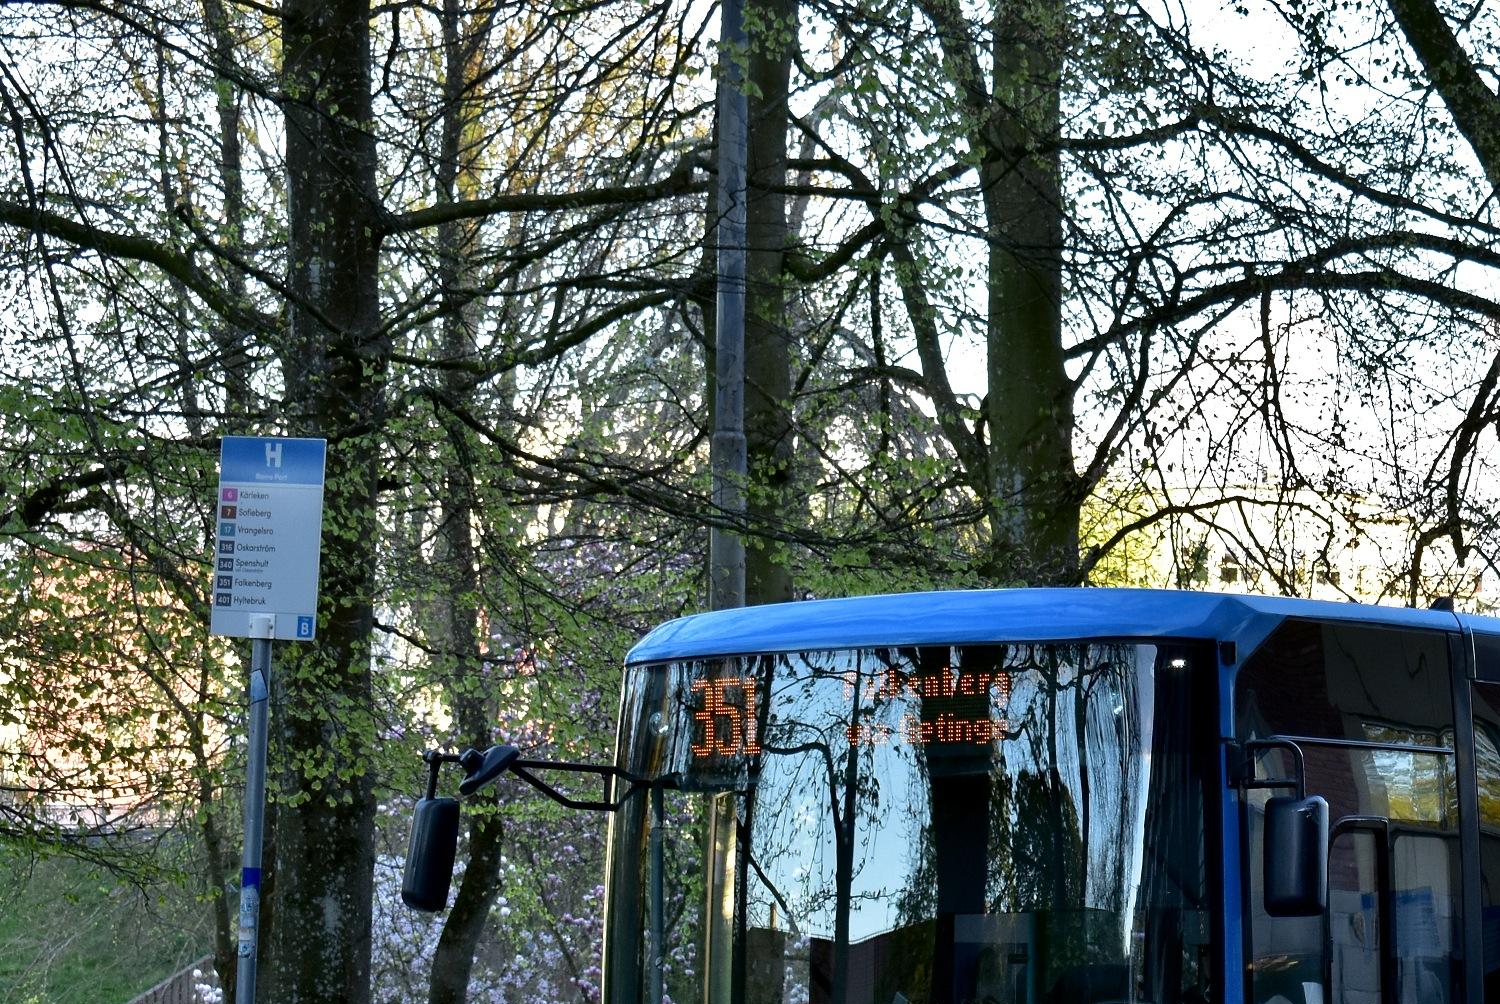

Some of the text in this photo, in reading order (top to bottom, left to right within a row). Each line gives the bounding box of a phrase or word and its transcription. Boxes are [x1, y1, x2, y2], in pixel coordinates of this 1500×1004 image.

[239, 508, 272, 519] Sofieberg
[224, 525, 274, 536] 17 Vrangelsro
[236, 543, 276, 553] Oskarström
[219, 559, 269, 569] 340 Spenshult
[219, 578, 272, 590] 351 Falkenberg
[217, 595, 266, 606] 401 Hyltebruk
[301, 622, 309, 636] B
[691, 667, 1013, 757] 351 Falkenberg
